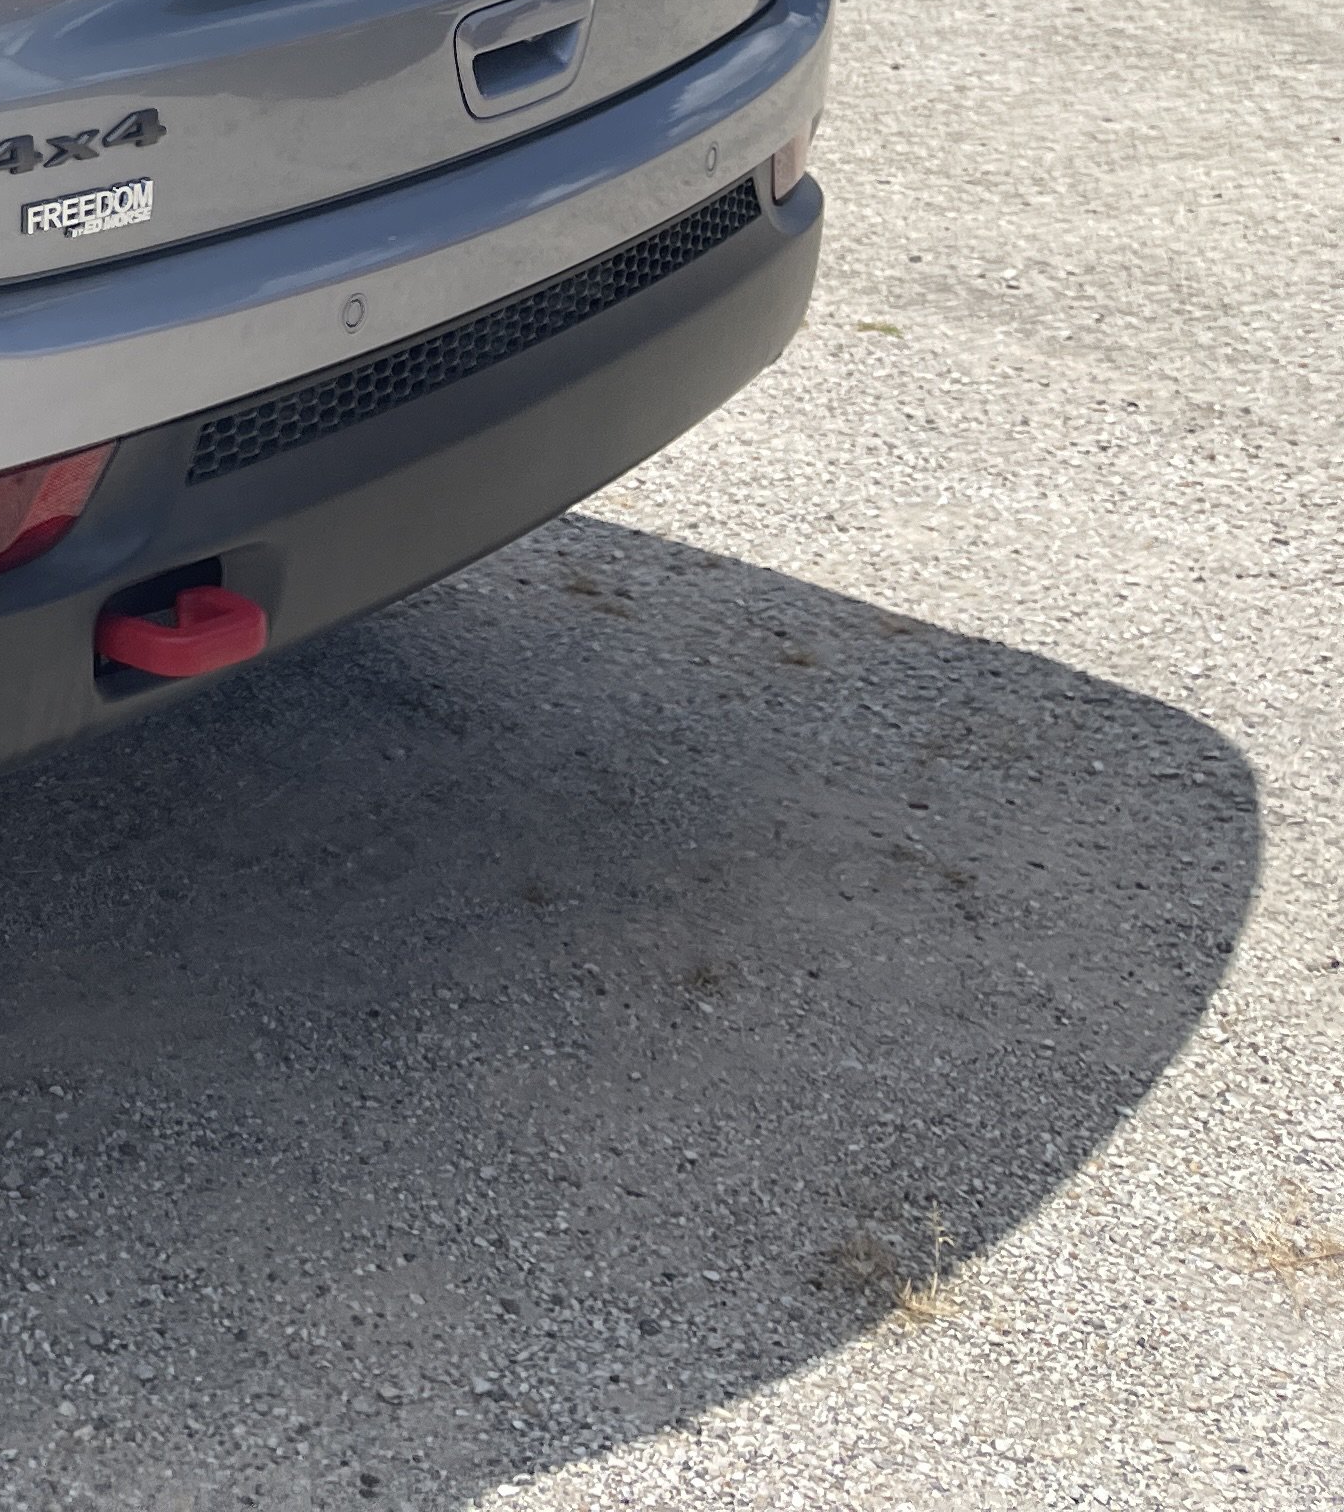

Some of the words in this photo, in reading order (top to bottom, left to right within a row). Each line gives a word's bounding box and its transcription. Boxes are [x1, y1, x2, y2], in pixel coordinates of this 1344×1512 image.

[23, 177, 155, 235] FREEDOM
[83, 218, 103, 235] ED
[102, 207, 152, 230] MORSE
